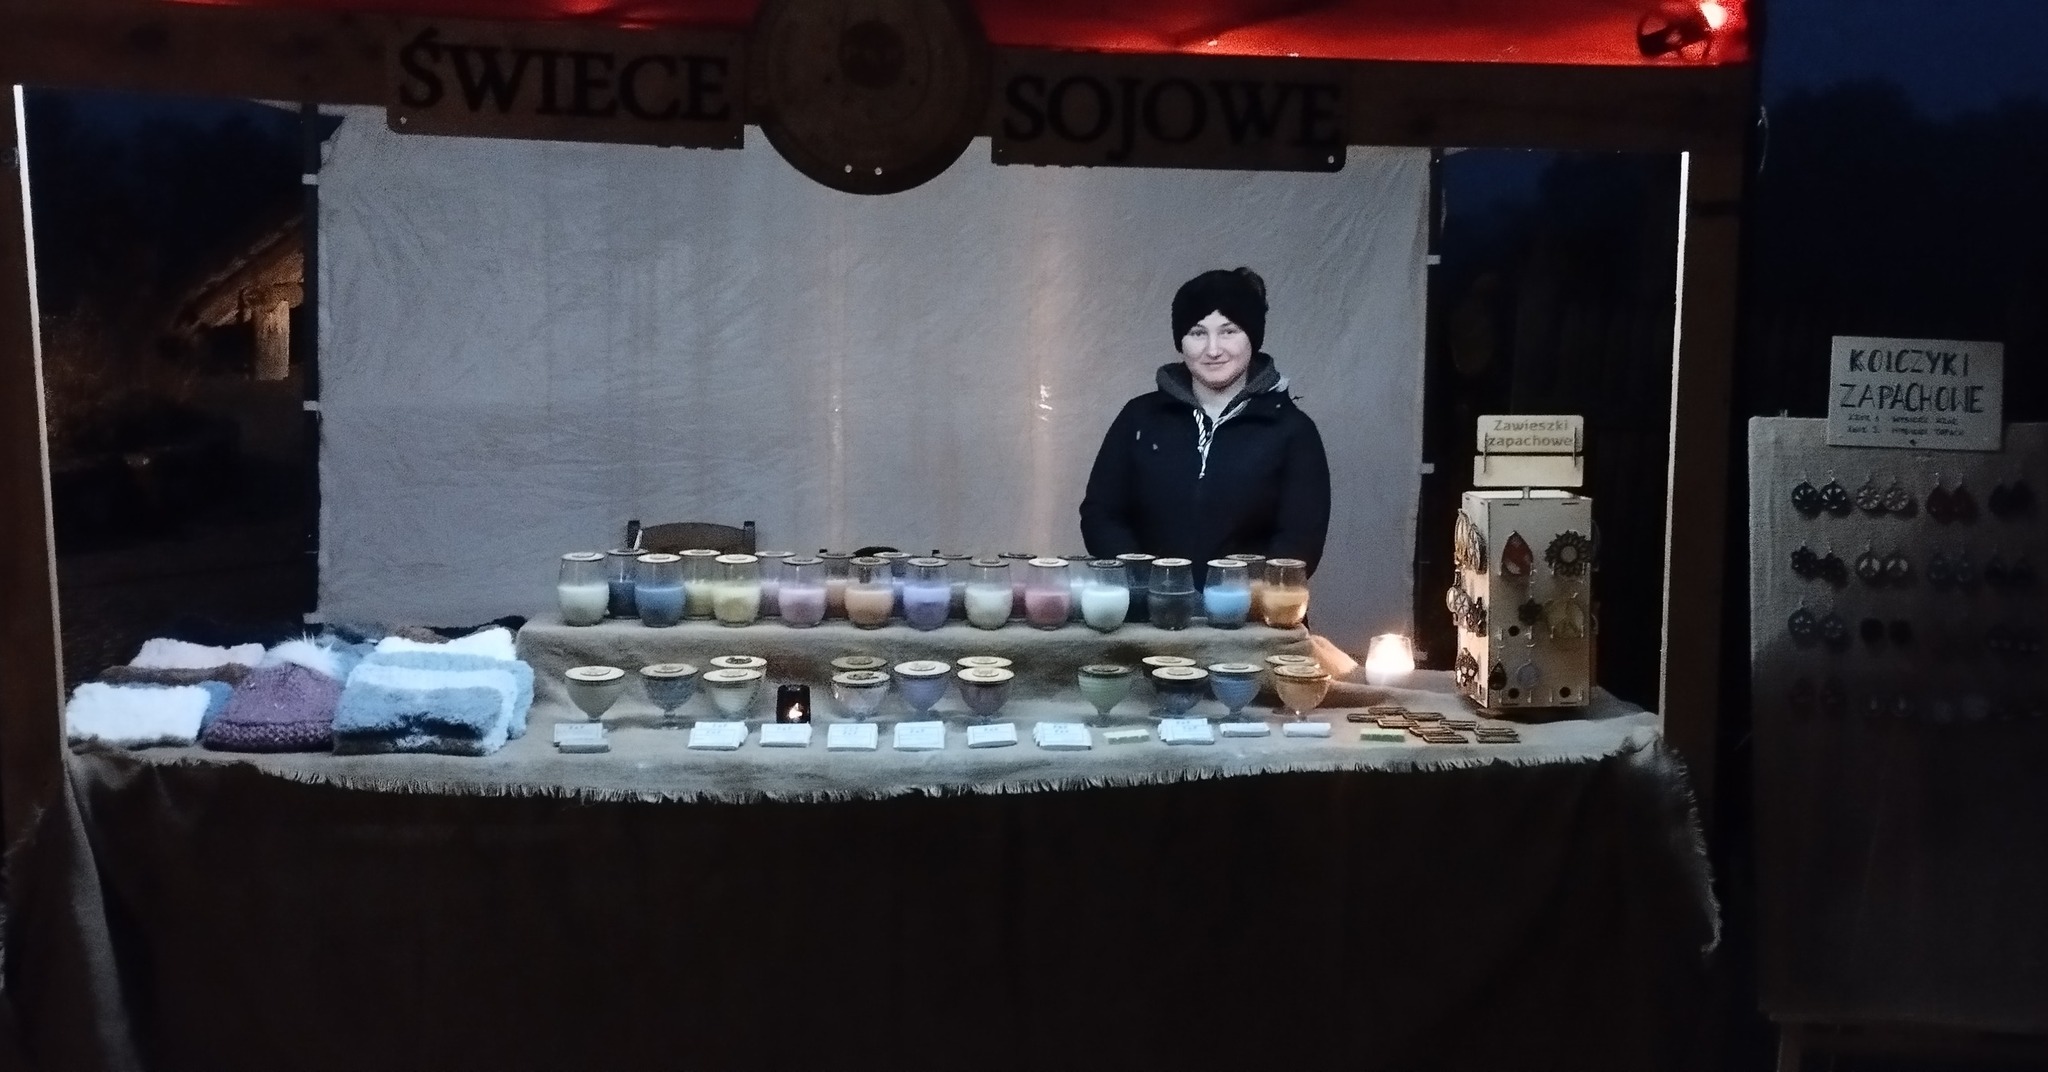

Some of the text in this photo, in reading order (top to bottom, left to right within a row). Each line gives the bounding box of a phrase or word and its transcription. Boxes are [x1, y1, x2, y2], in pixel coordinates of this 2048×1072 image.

[399, 26, 1342, 162] ŚWIECE SOJOWE
[1849, 349, 1969, 377] KOLCZYKI
[1840, 382, 1984, 413] ZAPACHOWE
[1493, 419, 1568, 431] Zawieszki
[1486, 434, 1573, 447] zapachowe
